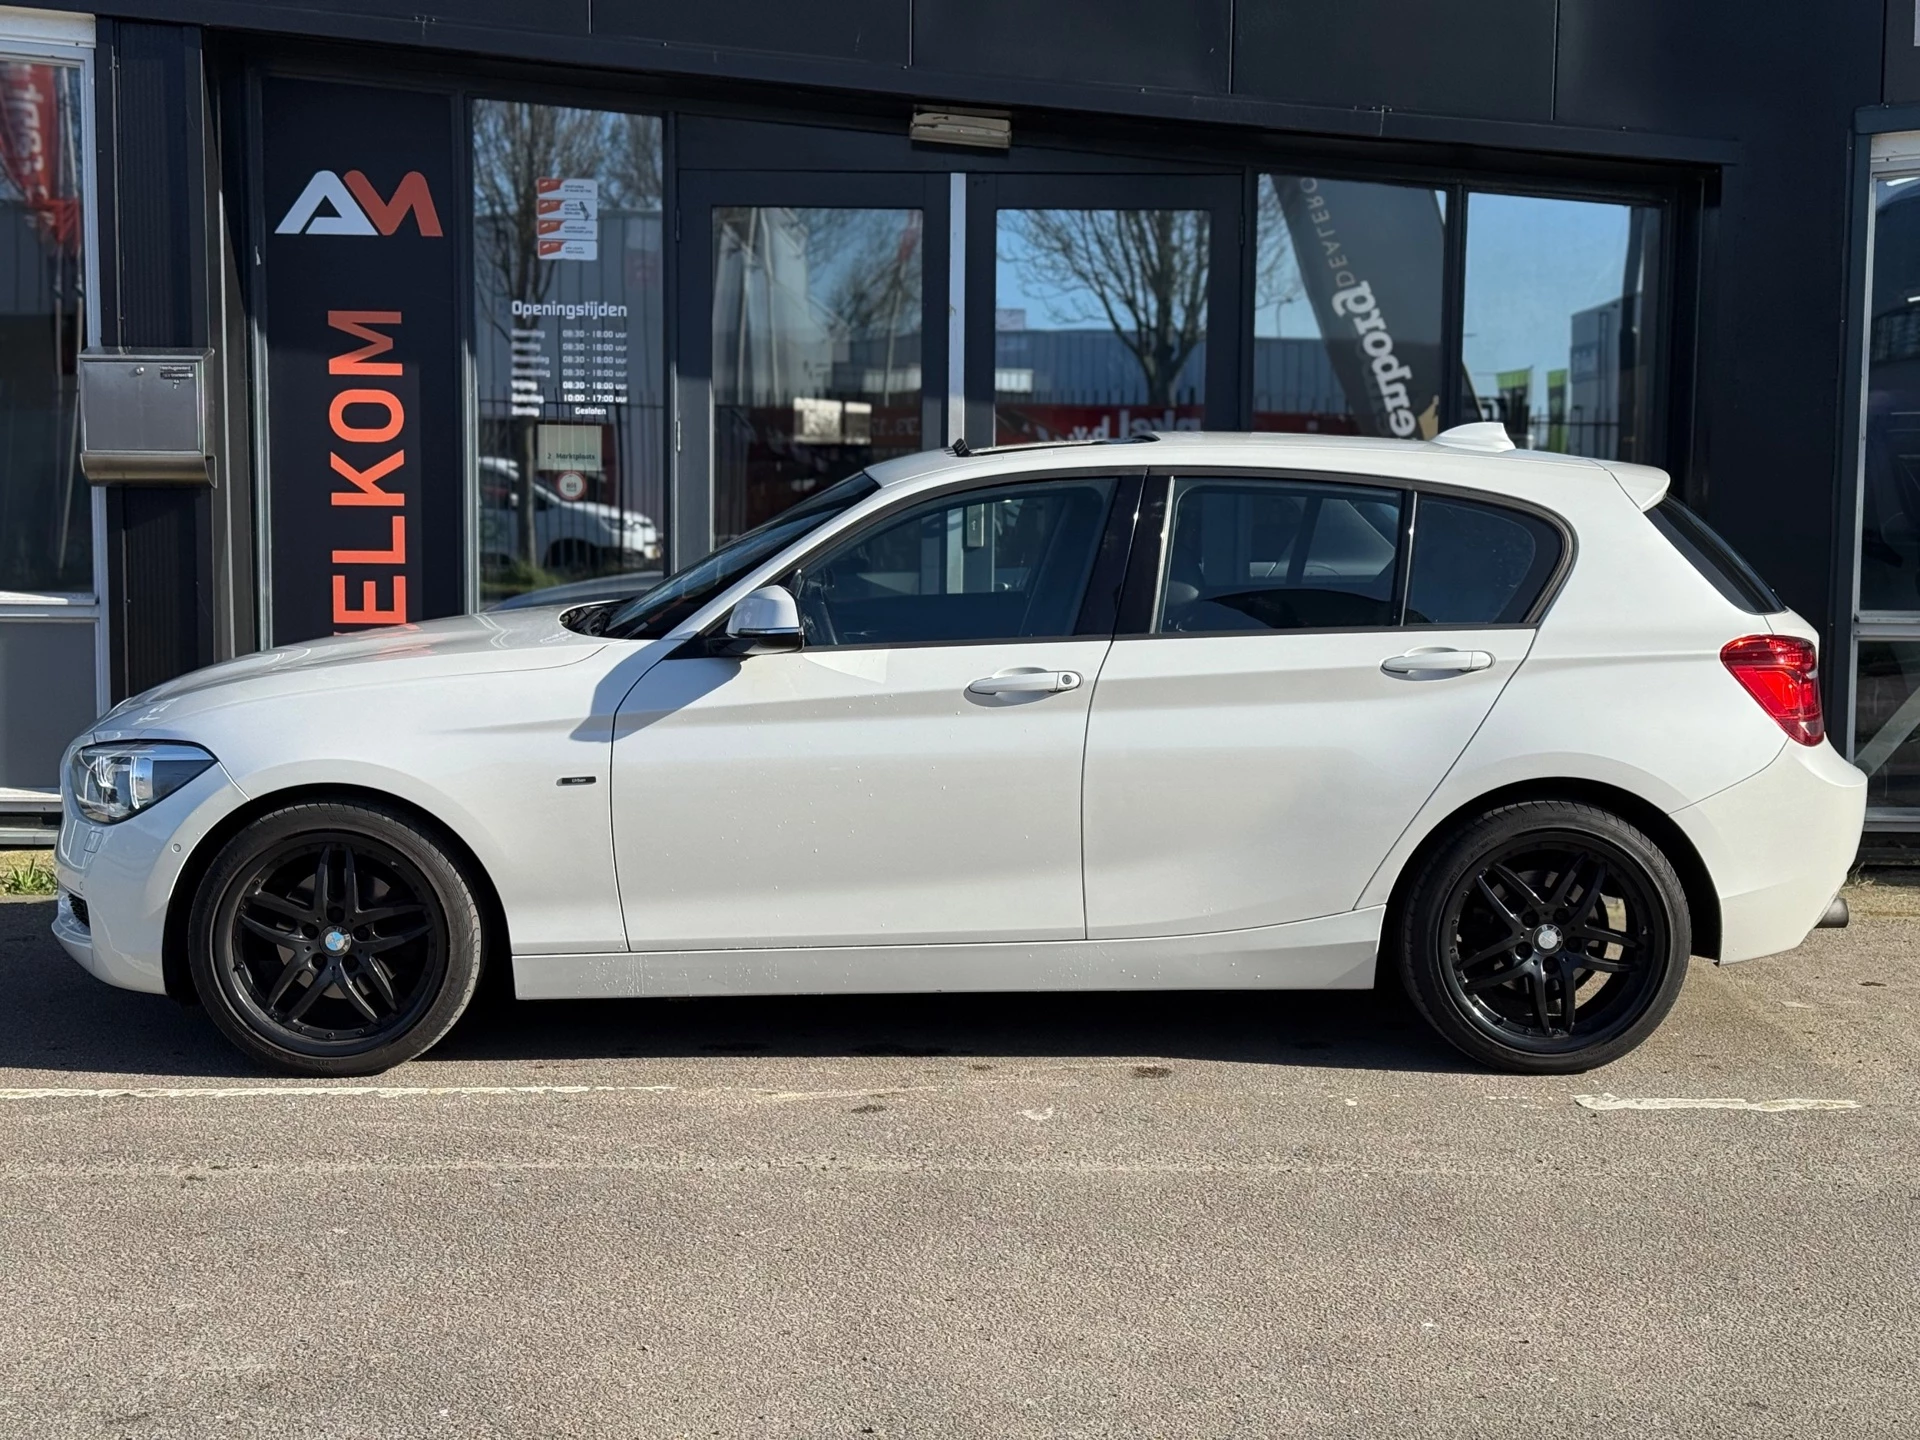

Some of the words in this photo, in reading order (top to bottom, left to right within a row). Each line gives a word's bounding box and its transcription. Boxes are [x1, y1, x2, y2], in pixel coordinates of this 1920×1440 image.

[511, 300, 628, 320] Openingstijden
[564, 394, 585, 402] 10:00
[592, 394, 614, 402] 17:00
[327, 310, 407, 636] ELKOM
